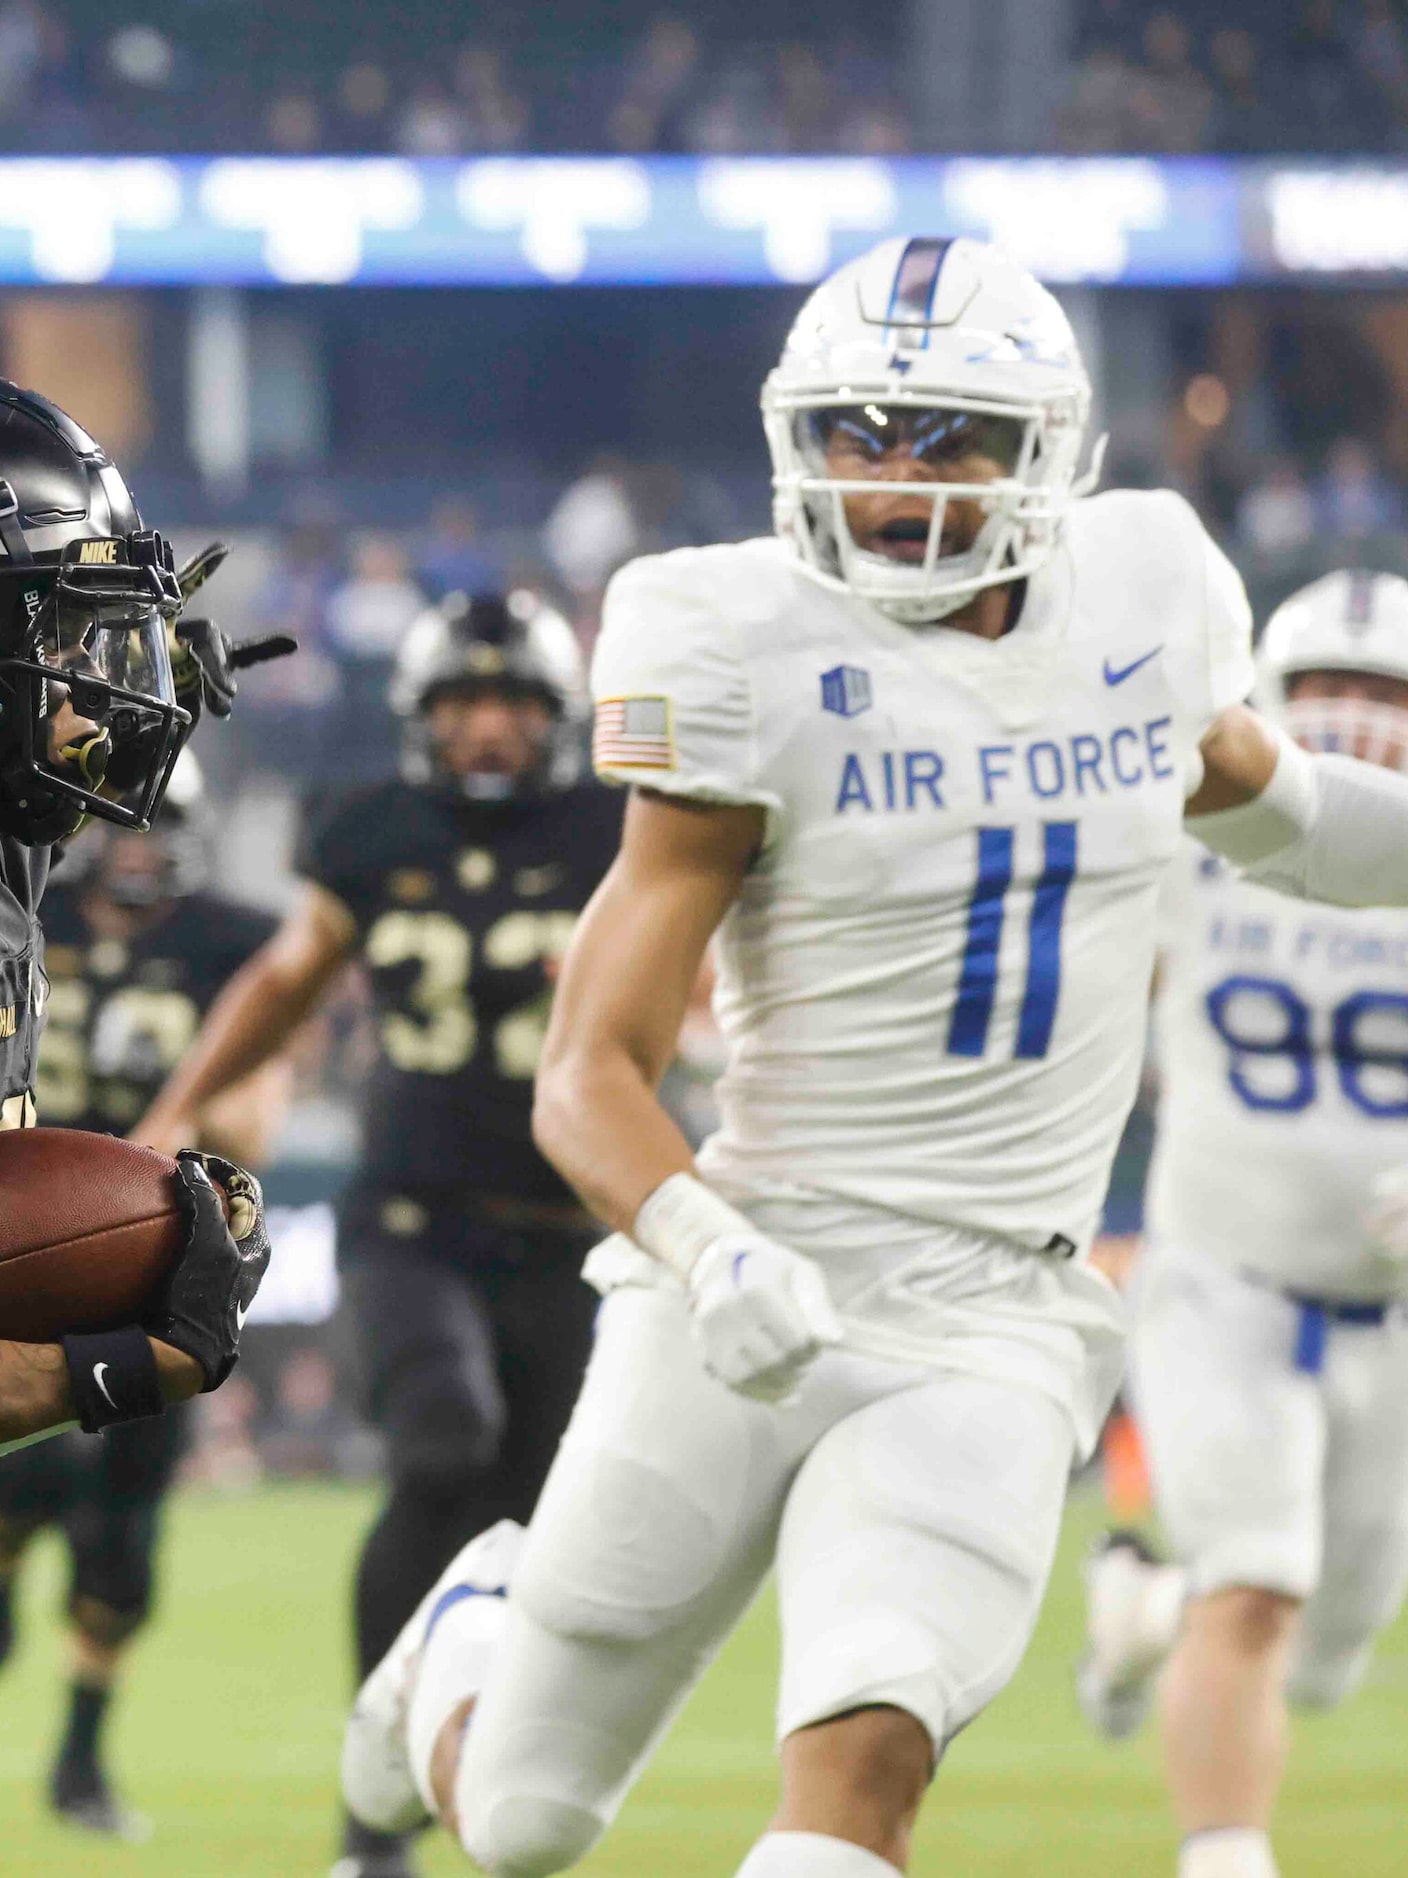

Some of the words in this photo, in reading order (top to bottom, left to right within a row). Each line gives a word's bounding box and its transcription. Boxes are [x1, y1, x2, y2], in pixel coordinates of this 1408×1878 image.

[79, 540, 118, 564] NIKE
[35, 644, 49, 719] KNGHTS
[835, 750, 945, 813] AIR
[978, 716, 1174, 805] FORCE
[945, 819, 1079, 1061] 11
[368, 910, 580, 1080] 32
